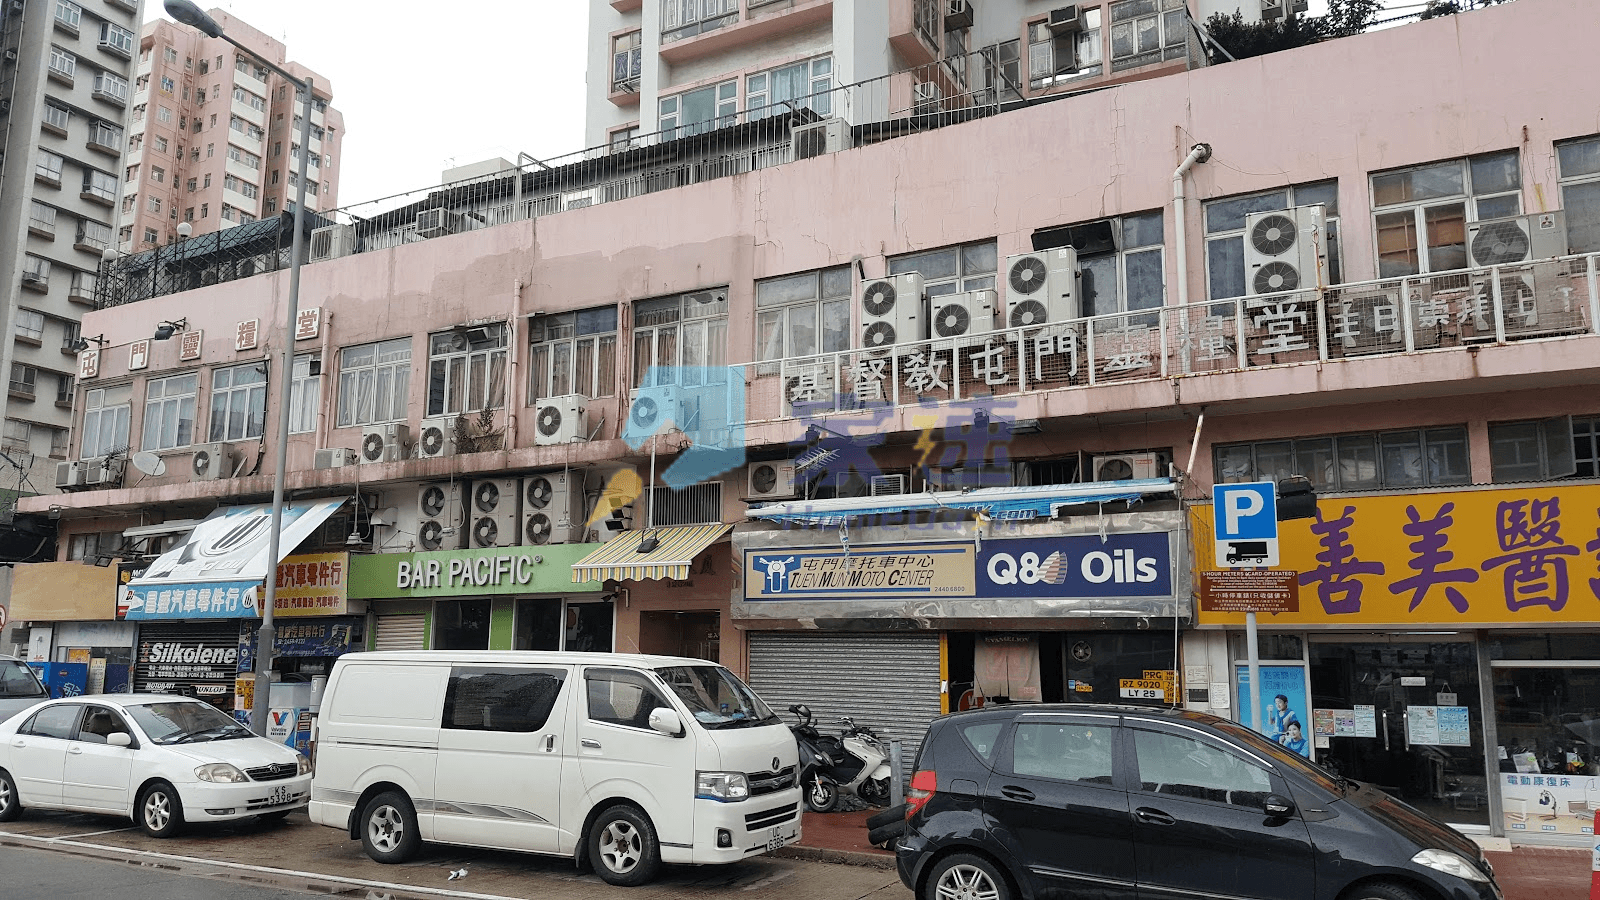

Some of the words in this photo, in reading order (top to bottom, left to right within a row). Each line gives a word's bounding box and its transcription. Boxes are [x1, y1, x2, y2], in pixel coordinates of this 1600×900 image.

[81, 311, 317, 376] 屯門靈糧堂
[1224, 489, 1264, 535] P
[803, 554, 934, 571] 屯門摩托車中心
[987, 551, 1040, 585] Q8
[1081, 548, 1157, 584] Oils
[1299, 497, 1600, 615] 善美醫
[263, 561, 341, 588] 盛汽車零件行
[397, 559, 441, 588] BAR
[819, 571, 848, 588] MUN
[848, 570, 886, 587] MOTO
[887, 569, 935, 587] CENTER
[145, 587, 240, 614] 昌盛汽車零件行
[149, 643, 237, 664] Silkolene
[1137, 681, 1161, 689] 9020
[1144, 671, 1162, 679] PRG
[274, 785, 286, 796] KS
[1506, 774, 1571, 788] 電動康復床
